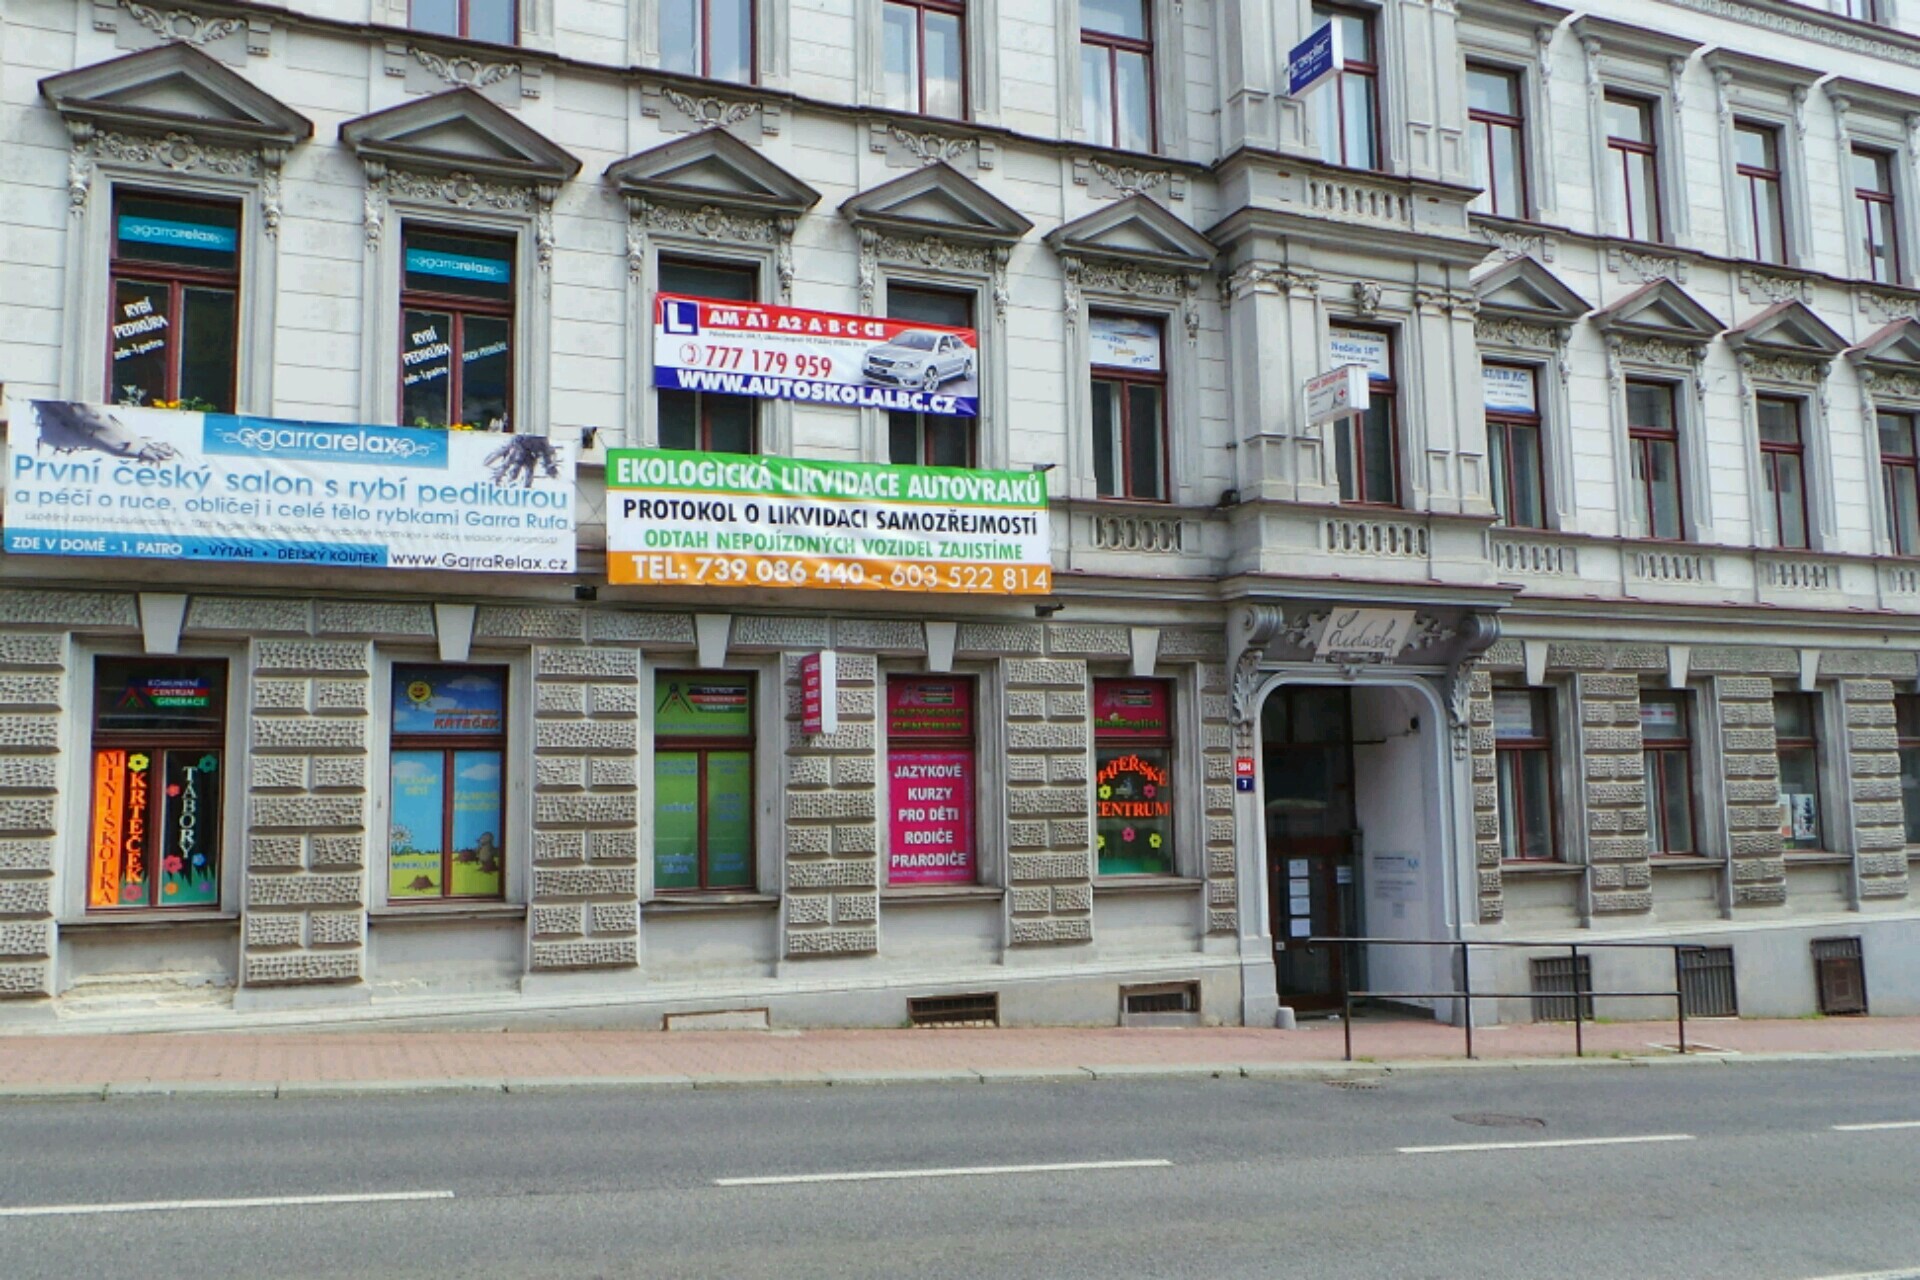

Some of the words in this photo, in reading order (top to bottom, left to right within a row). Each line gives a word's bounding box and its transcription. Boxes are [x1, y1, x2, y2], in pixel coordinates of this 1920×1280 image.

[124, 296, 153, 318] RYBÍ
[667, 302, 693, 332] L
[113, 315, 168, 338] PEDIKÚRA
[708, 310, 739, 326] AM
[746, 313, 769, 327] A1
[777, 316, 801, 330] A2
[808, 318, 822, 332] A
[829, 320, 841, 333] B
[847, 321, 858, 335] C
[864, 323, 885, 337] CE
[412, 325, 438, 346] RYBÍ
[402, 343, 452, 366] PEDIKÚRA
[706, 345, 743, 369] 777
[752, 350, 787, 374] 179
[795, 353, 832, 378] 959
[676, 368, 958, 415] WWW.AUTOSKOLALBC.CZ
[258, 428, 398, 454] garrarelax
[15, 454, 102, 484] První
[113, 459, 212, 491] český
[226, 470, 313, 497] salon
[325, 479, 339, 498] s
[349, 476, 408, 508] rybí
[418, 482, 568, 509] pedikúrou
[617, 457, 773, 490] EKOLOGICKÁ
[781, 465, 900, 497] LIKVIDACE
[908, 474, 1040, 504] AUTOVRAKŮ
[15, 489, 30, 504] a
[39, 487, 92, 508] péčí
[98, 494, 113, 507] o
[120, 495, 177, 512] ruce,
[185, 498, 260, 518] obličej
[265, 500, 271, 516] i
[278, 501, 326, 518] celé
[332, 502, 370, 520] tělo
[377, 507, 460, 527] rybkami
[465, 511, 520, 528] Garra
[623, 499, 737, 522] PROTOKOL
[745, 503, 759, 524] O
[768, 505, 867, 528] LIKVIDACI
[876, 509, 1037, 535] SAMOZŘEJMOSTÍ
[12, 537, 39, 549] ZDE
[44, 538, 56, 550] V
[61, 537, 107, 552] DOMĚ
[122, 541, 133, 553] 1.
[136, 542, 182, 554] PATRO
[208, 544, 253, 558] VÝTAH
[644, 529, 708, 549] ODTAH
[716, 530, 856, 554] NEPOJÍZDNÝCH
[862, 538, 933, 557] VOZIDEL
[938, 539, 1023, 560] ZAJISTÍME
[278, 547, 326, 561] DĚTSKÝ
[329, 551, 378, 564] KOUTEK
[391, 552, 568, 571] www.GarraRelax.cz
[631, 555, 688, 580] TEL:
[695, 557, 748, 582] 739
[756, 560, 808, 584] 086
[815, 561, 864, 585] 440
[889, 564, 938, 588] 603
[949, 566, 993, 589] 522
[1002, 567, 1048, 590] 814
[148, 678, 199, 687] KOMUNITNÍ
[152, 688, 195, 696] CENTRUM
[156, 697, 206, 706] GENERACE
[894, 763, 962, 778] JAZYKOVÉ
[908, 787, 953, 801] KURZY
[1242, 779, 1247, 789] 7
[898, 808, 925, 821] PRO
[929, 805, 959, 821] DĚTI
[904, 828, 953, 844] RODIČE
[892, 850, 967, 867] PRARODIČE
